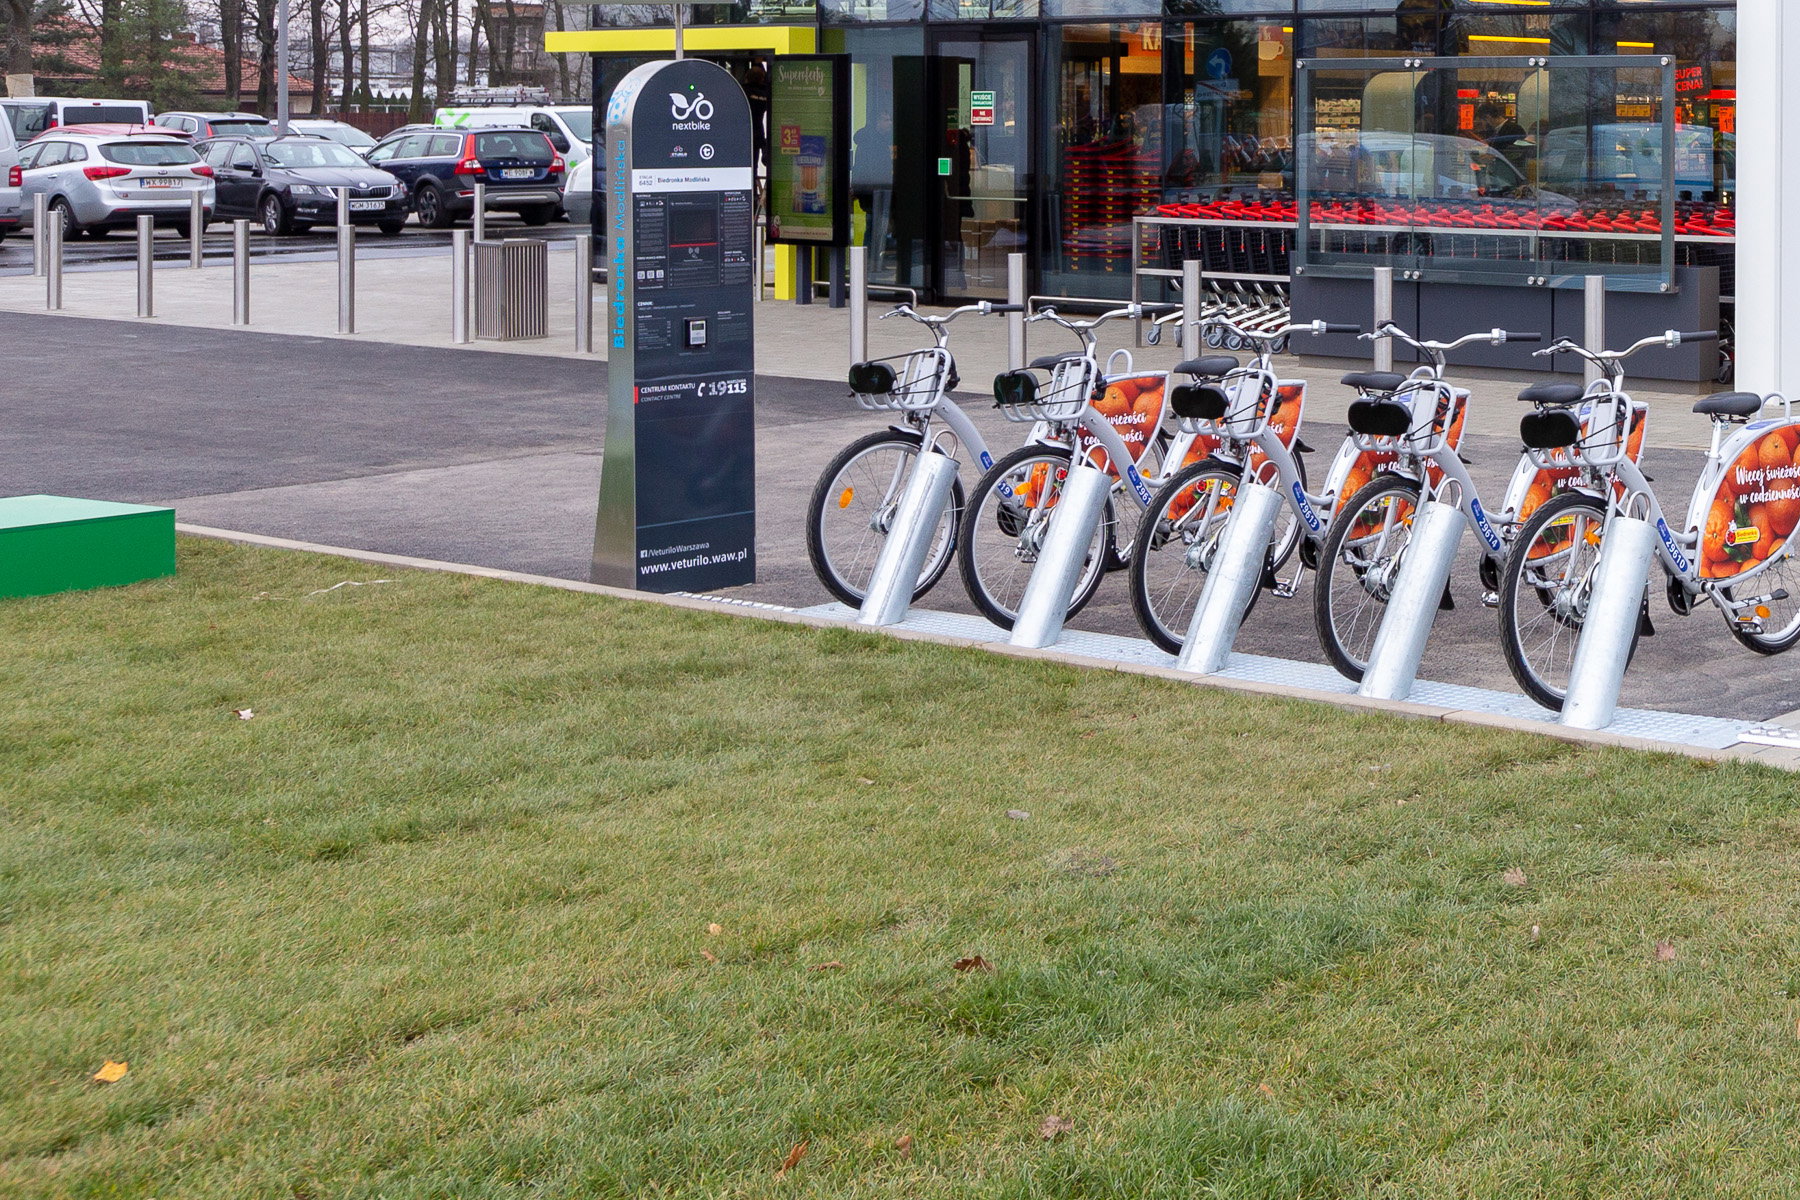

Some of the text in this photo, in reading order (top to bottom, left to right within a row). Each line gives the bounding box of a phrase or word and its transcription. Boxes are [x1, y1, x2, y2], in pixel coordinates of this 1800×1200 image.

[1674, 66, 1702, 79] SUPER
[1675, 78, 1704, 91] CENA!
[672, 121, 711, 131] nextbike
[613, 140, 625, 348] Modlińska Biedronka
[640, 385, 667, 394] CENTRUM
[668, 383, 696, 392] KONTAKTU
[1736, 465, 1765, 486] Więcej
[1136, 482, 1152, 505] 2961
[1300, 500, 1318, 528] 29613
[1479, 517, 1498, 548] 29614
[640, 548, 748, 575] www.veturilo.waw.pl
[1665, 538, 1686, 569] 29610
